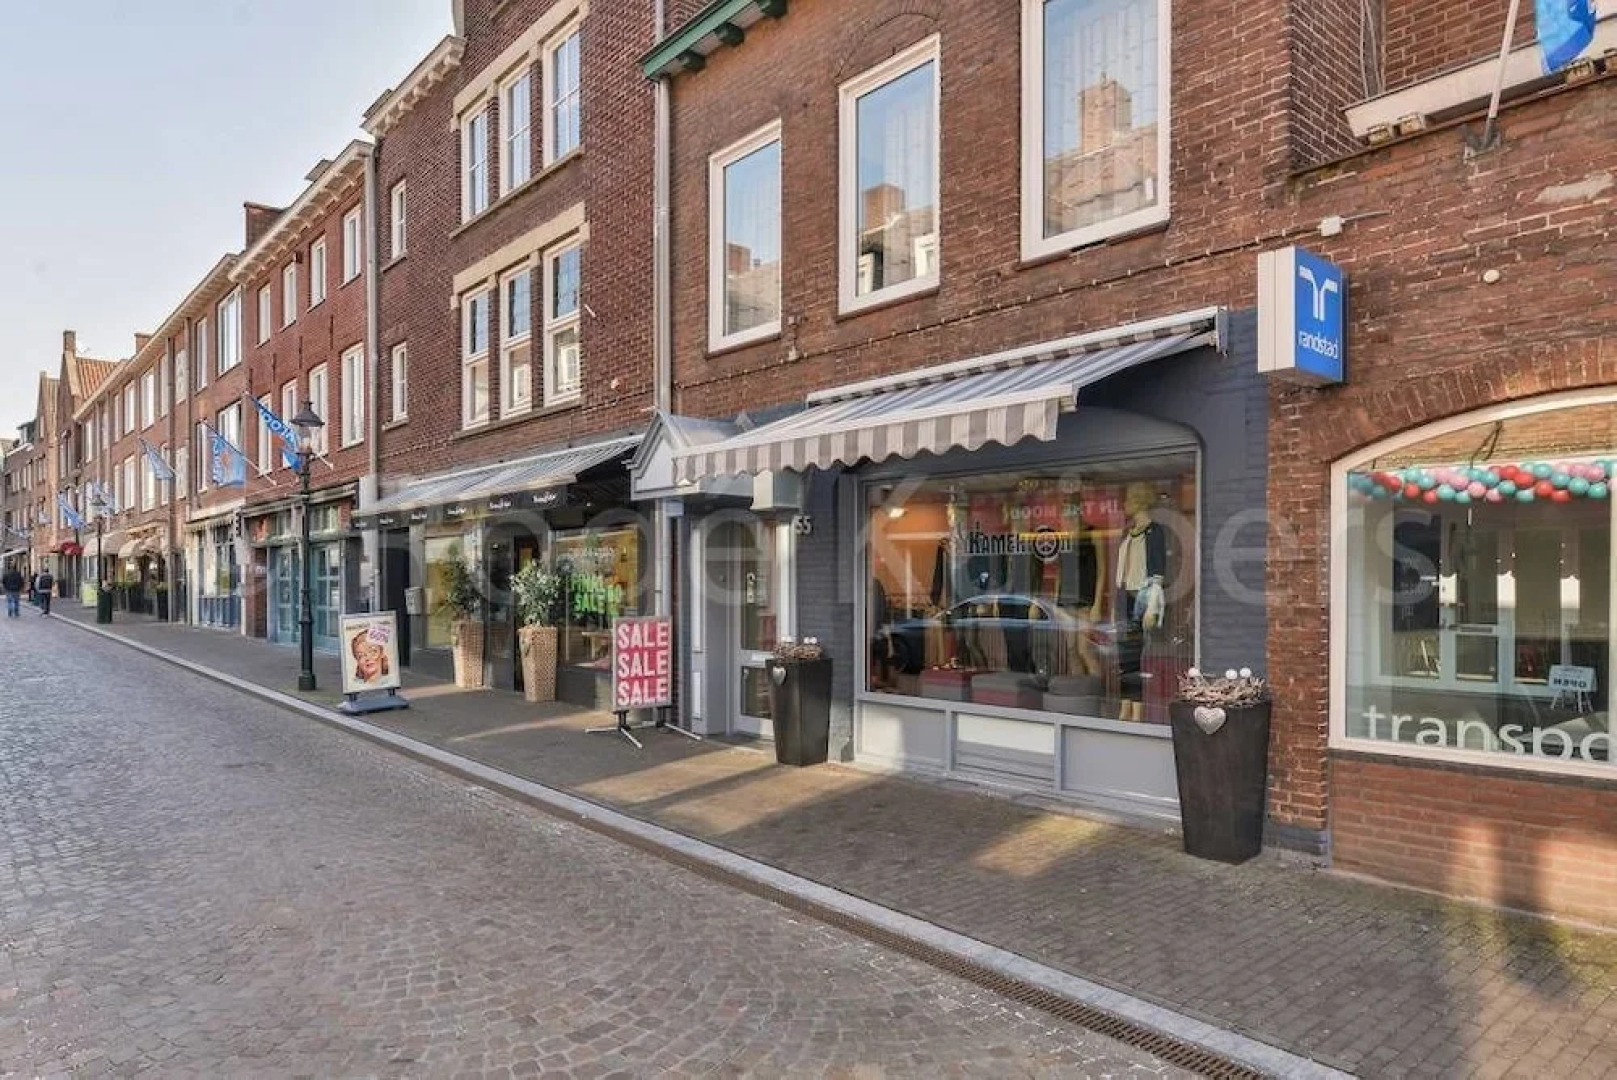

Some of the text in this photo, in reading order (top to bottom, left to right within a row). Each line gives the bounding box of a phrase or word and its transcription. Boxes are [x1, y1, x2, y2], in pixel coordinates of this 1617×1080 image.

[1299, 330, 1338, 359] randstad
[793, 515, 811, 534] 55
[618, 622, 669, 649] SALE
[618, 650, 669, 678] SALE
[618, 678, 669, 706] SALE
